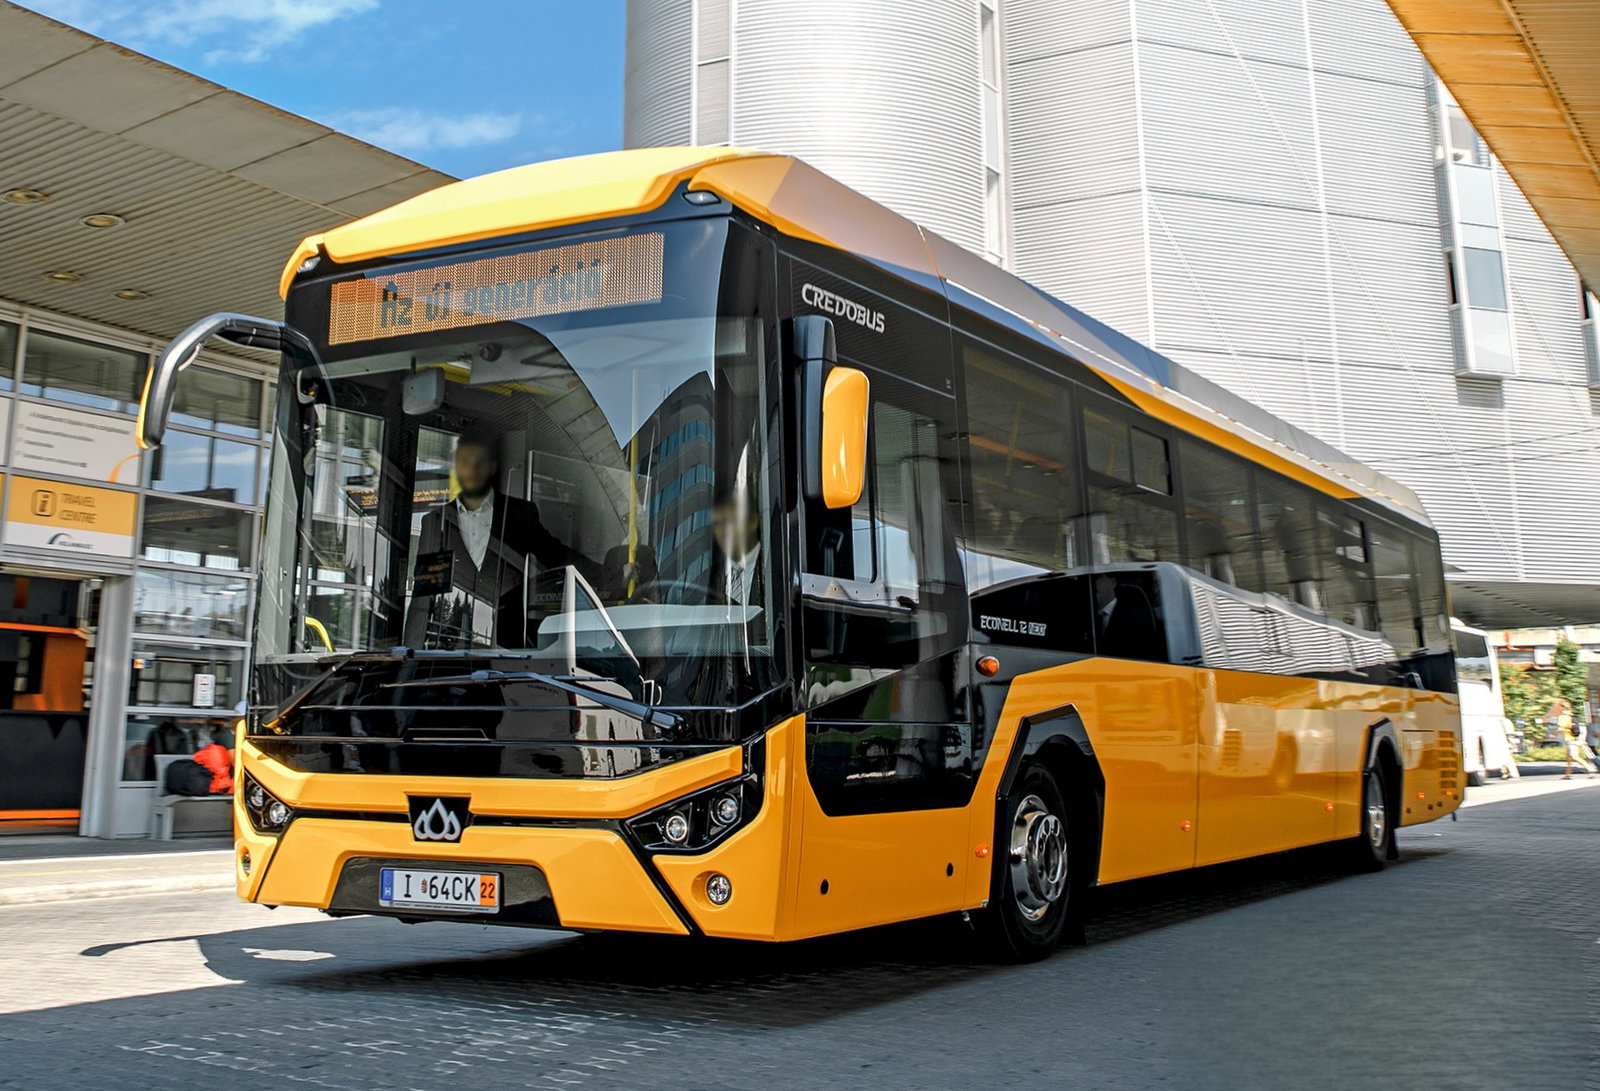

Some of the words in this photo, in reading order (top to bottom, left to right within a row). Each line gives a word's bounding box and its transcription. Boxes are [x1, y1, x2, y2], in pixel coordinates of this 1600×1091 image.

[380, 280, 413, 328] Az
[462, 257, 602, 316] generáció
[801, 282, 885, 334] CREDOBUS
[60, 493, 97, 508] TRAVEL
[58, 509, 97, 524] CENTRE
[980, 614, 1019, 633] ECONELL
[1019, 620, 1028, 635] 12
[429, 875, 476, 902] 64CK
[480, 881, 496, 899] 22
